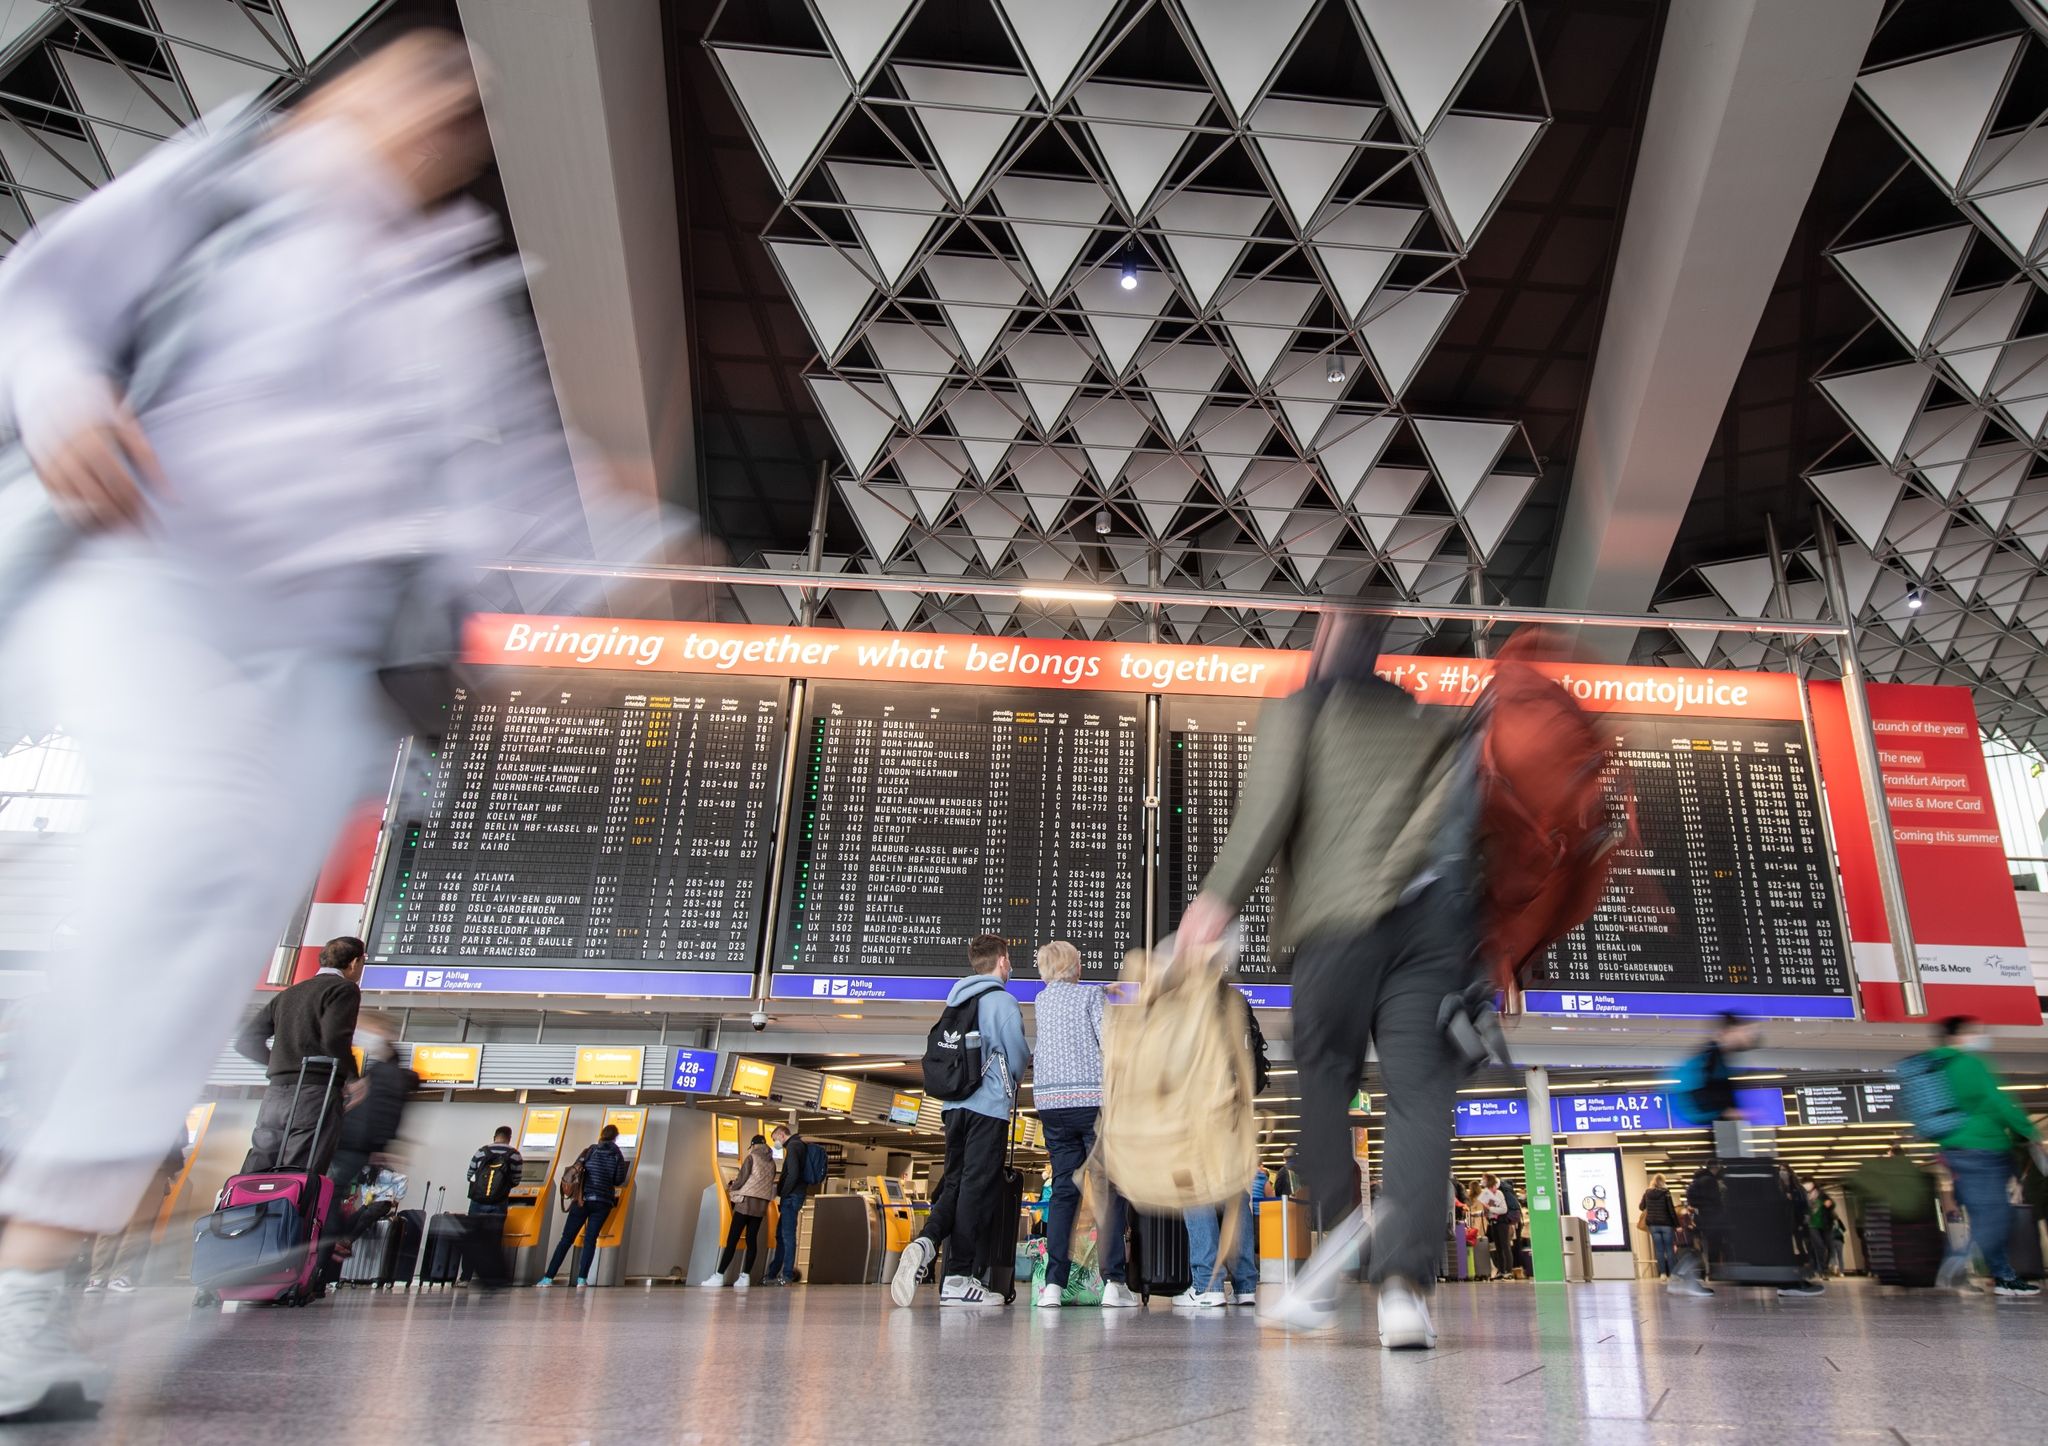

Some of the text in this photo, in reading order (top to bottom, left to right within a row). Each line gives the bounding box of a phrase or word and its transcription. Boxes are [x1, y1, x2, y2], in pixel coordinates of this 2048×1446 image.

[504, 623, 1265, 688] Bringing together what belongs together
[508, 706, 547, 714] GLASGOW
[709, 714, 747, 722] 263-498
[506, 716, 583, 725] DORTMUND-KOELN
[883, 721, 914, 729] DUBLIN
[1872, 721, 1964, 736] Launch of the year
[882, 730, 924, 738] WARSCHAU
[502, 735, 552, 743] STUTTGART
[881, 740, 933, 748] DOHA-HAMAD
[500, 744, 606, 754] STUTTGART-CANCELLED
[880, 749, 969, 758] WASHINGTON-DULLES
[1878, 752, 1921, 763] The new
[900, 759, 937, 767] ANGELES
[1188, 761, 1198, 769] LH
[496, 763, 597, 773] KARLSRUHE-MANNHEIM
[878, 768, 957, 777] LONDON-HEATHROW
[494, 773, 578, 782] LONDON-HEATHROW
[1882, 774, 1966, 789] Frankfurt Airport
[492, 783, 599, 793] NUERNBERG-CANCELLED
[877, 786, 908, 794] MUSCAT
[488, 802, 540, 811] STUTTGART
[1887, 797, 1981, 810] Miles & More Card
[875, 806, 981, 816] MUENCHEN-WUERZBURG-N
[1188, 807, 1198, 815] DE
[486, 812, 515, 820] KOELN
[484, 822, 519, 830] BERLIN
[524, 824, 581, 832] HBF-KASSEL
[873, 825, 910, 833] DETROIT
[482, 832, 517, 840] NEAPEL
[1893, 829, 1999, 844] Coming this summer
[480, 842, 509, 850] KAIRO
[871, 844, 946, 853] HAMBURG-KASSEL
[870, 854, 903, 862] AACHEN
[869, 864, 966, 874] BERLIN-BRANDENBURG
[474, 873, 515, 881] ATLANTA
[868, 874, 939, 883] ROM-FIUMICINO
[493, 894, 540, 903] AVIV-BEN
[545, 896, 580, 904] GURION
[866, 894, 894, 902] MIAMI
[467, 904, 555, 914] OSLO-GARDERMOEN
[865, 904, 904, 912] SEATTLE
[518, 916, 565, 924] MALLORCA
[864, 914, 941, 923] MAILAND-LINATE
[463, 926, 528, 934] DUESSELDORF
[863, 925, 940, 933] MADRID-BARAJAS
[1240, 924, 1266, 932] SPLIT
[1594, 924, 1669, 932] LONDON-HEATHROW
[461, 936, 491, 944] PARIS
[537, 938, 573, 946] GAULLE
[482, 947, 536, 956] FRANCISCO
[862, 945, 911, 953] CHARLOTTE
[860, 956, 894, 964] DUBLIN
[1240, 954, 1271, 962] TIRANA
[1240, 965, 1276, 973] ANTALYA
[1598, 963, 1674, 971] OSLO-GARDERMOEN
[1941, 964, 1947, 972] &
[1949, 965, 1971, 973] More
[446, 971, 469, 980] Abflug
[1599, 973, 1665, 981] FUERTEVENTURA
[444, 981, 482, 990] Departures
[850, 979, 873, 989] Abflug
[850, 989, 885, 997] Departures
[1595, 996, 1614, 1004] Abflug
[1595, 1004, 1627, 1012] Departures
[937, 1041, 958, 1049] adidas
[679, 1061, 704, 1075] 428-
[548, 1077, 569, 1085] 464
[676, 1076, 697, 1088] 499
[1509, 1102, 1517, 1114] C
[1621, 1115, 1641, 1129] D,E
